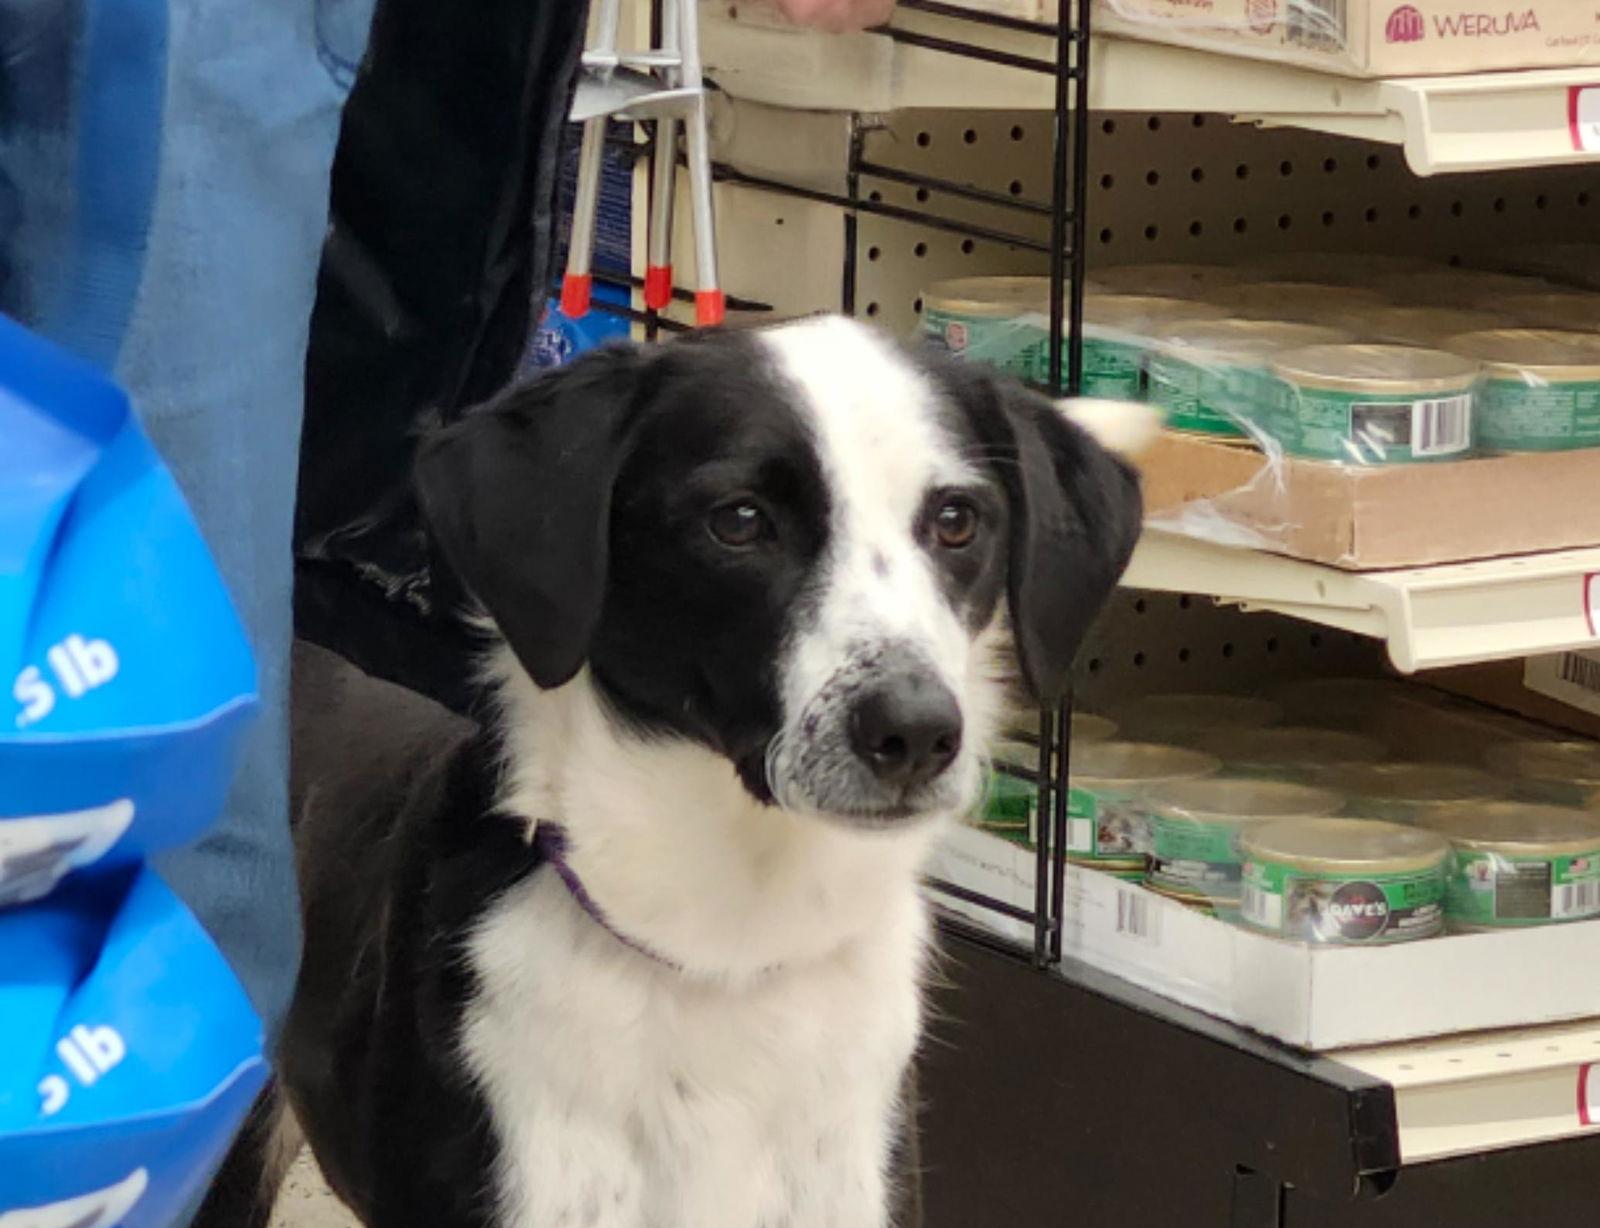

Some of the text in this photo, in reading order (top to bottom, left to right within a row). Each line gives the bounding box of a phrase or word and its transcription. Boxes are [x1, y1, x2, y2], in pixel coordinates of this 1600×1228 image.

[1432, 8, 1541, 39] WERUVA
[47, 633, 119, 698] lb
[56, 1023, 126, 1087] lb
